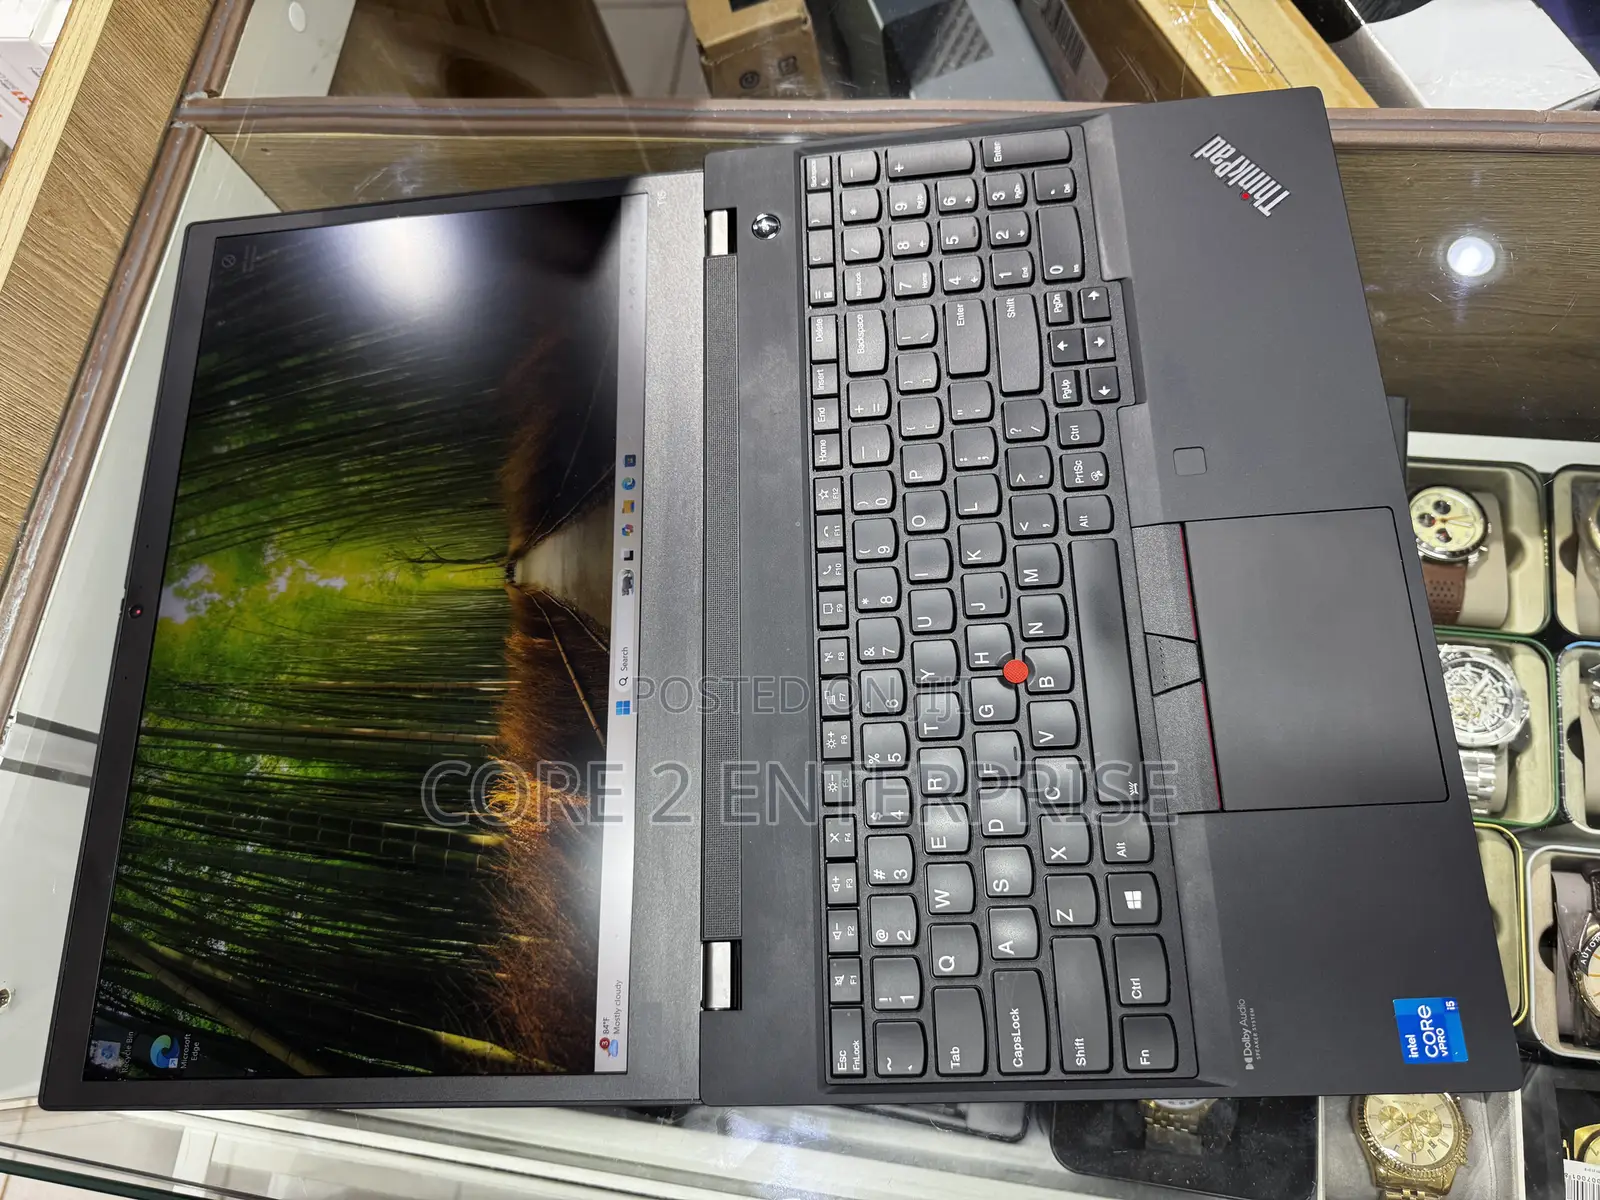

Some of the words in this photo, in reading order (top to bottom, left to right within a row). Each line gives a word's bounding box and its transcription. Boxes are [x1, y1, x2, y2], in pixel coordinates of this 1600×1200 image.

[994, 141, 1002, 162] Enter
[1193, 135, 1290, 217] ThinkPad
[943, 196, 956, 206] 6
[992, 191, 1005, 201] 3
[895, 202, 908, 211] 9
[946, 236, 959, 245] 5
[996, 229, 1009, 239] 2
[1050, 265, 1063, 274] 0
[900, 282, 912, 290] 7
[949, 276, 961, 285] 4
[1007, 297, 1016, 318] Shift
[1053, 294, 1063, 313] PgDn
[956, 304, 965, 327] Enter
[857, 314, 865, 354] Backspace
[817, 369, 825, 390] Insert
[1062, 379, 1072, 399] PgUp
[818, 407, 826, 423] End
[1070, 425, 1079, 441] Ctrl
[819, 439, 827, 462] Home
[909, 470, 922, 479] P
[1074, 460, 1084, 483] PrtSc
[875, 498, 888, 506] 0
[964, 502, 978, 512] L
[912, 515, 926, 527] O
[1079, 515, 1089, 528] Alt
[877, 545, 890, 554] 9
[967, 550, 982, 561] K
[1024, 569, 1038, 582] M
[880, 595, 893, 604] 8
[837, 604, 843, 612] F9
[971, 602, 986, 611] J
[917, 617, 932, 628] U
[1028, 622, 1044, 634] N
[838, 652, 845, 661] F8
[882, 647, 896, 655] 7
[620, 646, 629, 672] Search
[975, 652, 989, 664] H
[920, 668, 935, 680] Y
[1039, 676, 1054, 688] B
[839, 692, 846, 702] F7
[885, 699, 899, 708] 6
[979, 704, 994, 718] G
[923, 723, 939, 734] T
[841, 734, 848, 745] F6
[1038, 731, 1054, 743] V
[888, 753, 902, 762] 5
[983, 763, 999, 774] F
[928, 777, 943, 790] R
[1044, 786, 1060, 800] C
[891, 810, 904, 820] 4
[988, 819, 1003, 832] D
[845, 833, 852, 842] F4
[931, 836, 947, 849] E
[1050, 846, 1068, 860] X
[1116, 842, 1128, 858] Alt
[894, 869, 908, 879] 3
[846, 878, 853, 888] F3
[993, 879, 1009, 892] S
[934, 889, 950, 908] W
[1056, 909, 1073, 922] Z
[848, 926, 854, 936] F2
[897, 930, 912, 941] 2
[998, 940, 1015, 955] A
[938, 956, 955, 972] Q
[850, 975, 857, 985] F1
[614, 979, 623, 1006] cloudy
[1130, 978, 1142, 999] Ctrl
[1445, 1000, 1456, 1011] i5
[1237, 998, 1248, 1027] Audio
[613, 1008, 623, 1035] Mostly
[126, 1031, 134, 1044] Bin
[1010, 1008, 1024, 1068] CapsLock
[1241, 1027, 1253, 1056] Dolby
[180, 1033, 192, 1069] Microsoft
[191, 1042, 200, 1061] Edge
[1075, 1038, 1086, 1067] Shift
[1404, 1034, 1419, 1058] intel
[838, 1050, 847, 1071] Esc
[951, 1047, 960, 1069] Tab
[1140, 1049, 1150, 1065] Fn
